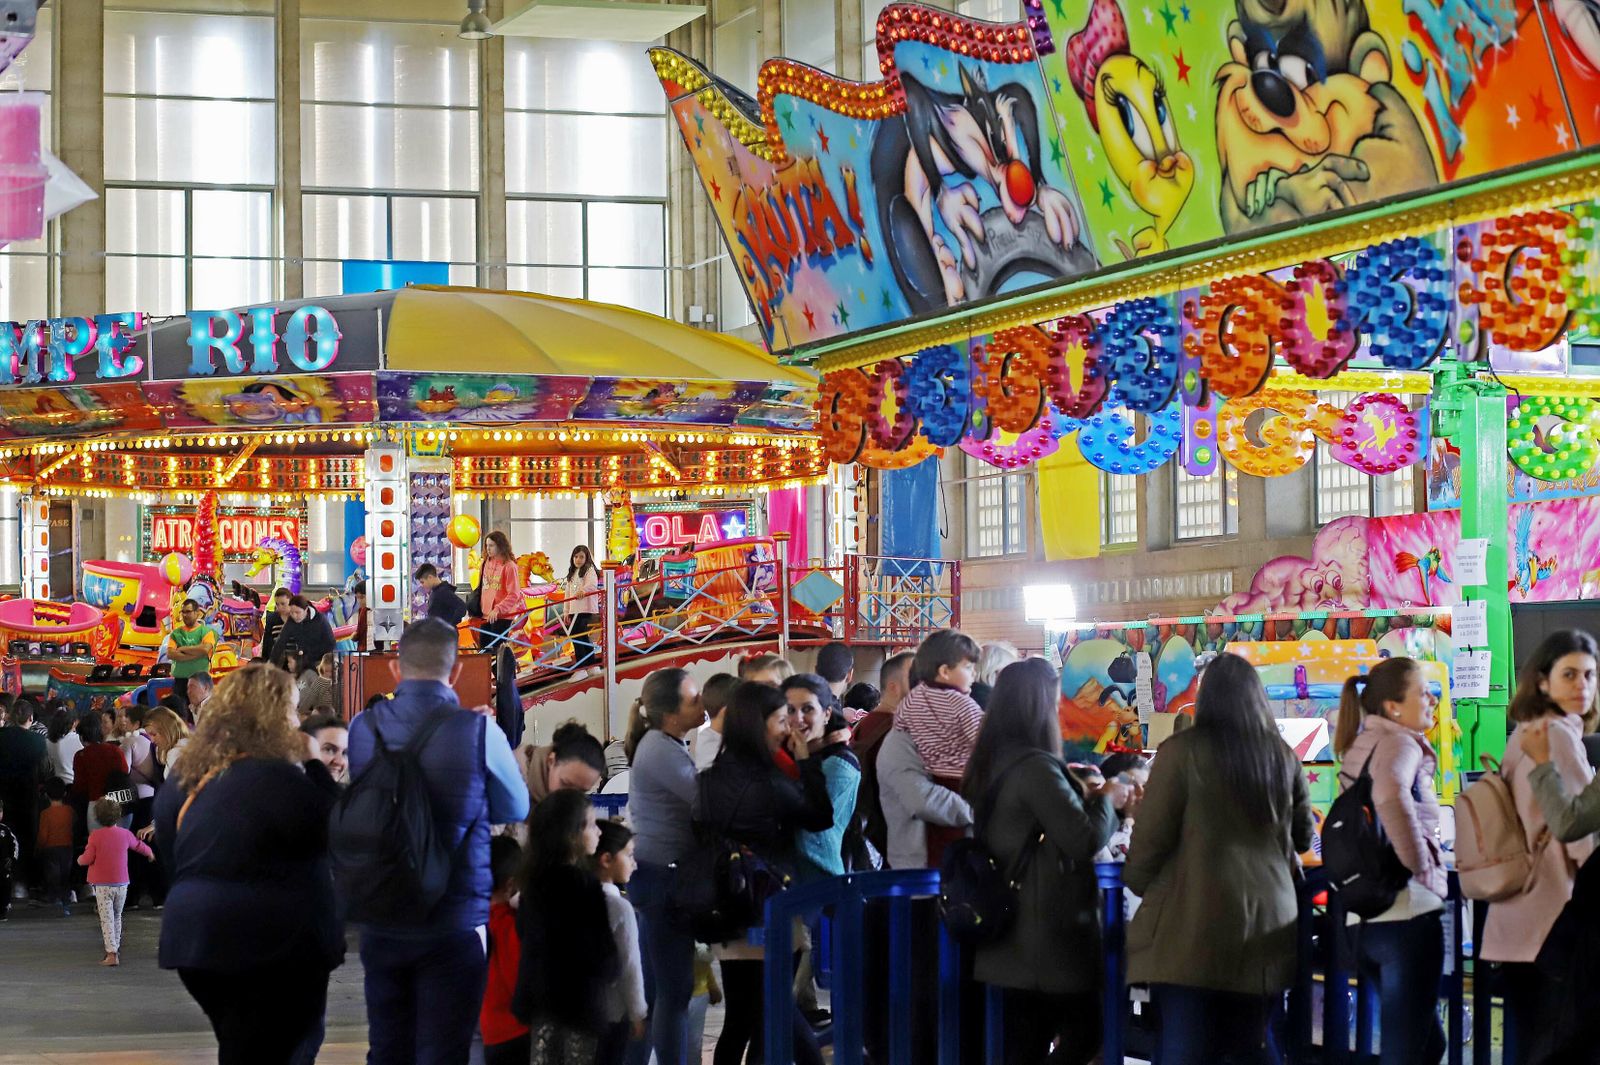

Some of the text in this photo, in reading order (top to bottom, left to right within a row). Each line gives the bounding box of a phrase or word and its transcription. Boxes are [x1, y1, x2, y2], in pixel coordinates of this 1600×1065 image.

[186, 305, 343, 375] RIO
[154, 518, 295, 549] ATRCIONES
[645, 514, 722, 547] OLA
